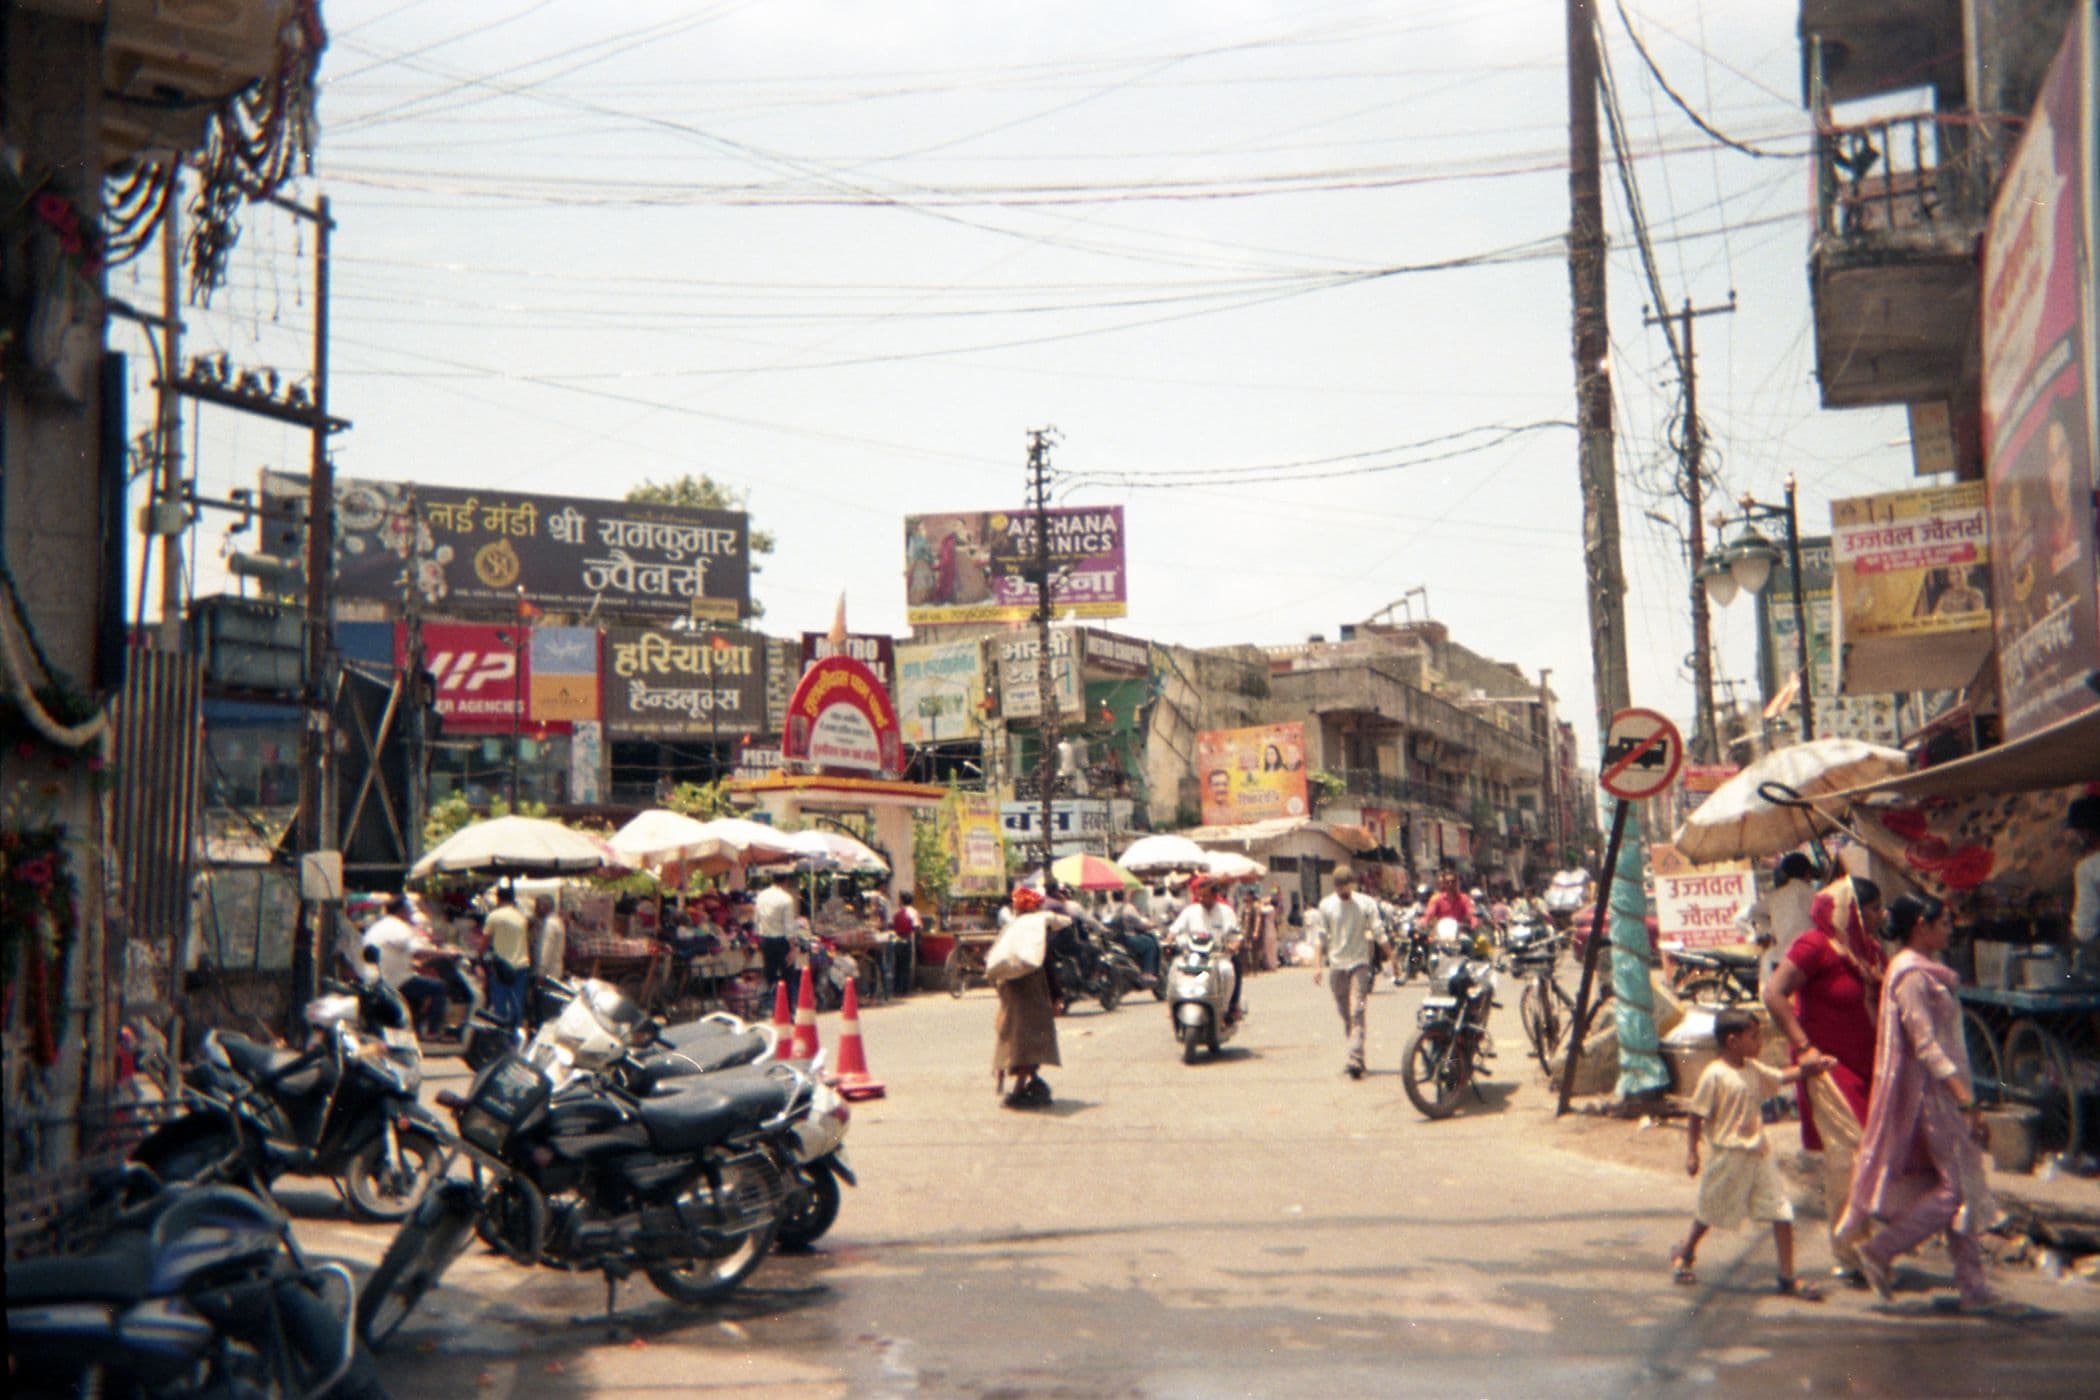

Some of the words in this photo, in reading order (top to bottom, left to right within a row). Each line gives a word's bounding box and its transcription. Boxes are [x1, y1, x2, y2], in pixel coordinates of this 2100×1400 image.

[426, 497, 478, 533] नई
[480, 500, 538, 536] मंडी
[548, 507, 587, 545] श्री
[598, 517, 738, 561] रामकुमार
[1017, 533, 1113, 555] ETNICS
[1842, 528, 1915, 551] उज्जवल
[1919, 511, 1984, 546] ज्वैलर्स
[582, 548, 712, 597] ज्वैलर्स
[612, 632, 753, 677] हरियाणा
[1664, 874, 1744, 898] उज्जवल
